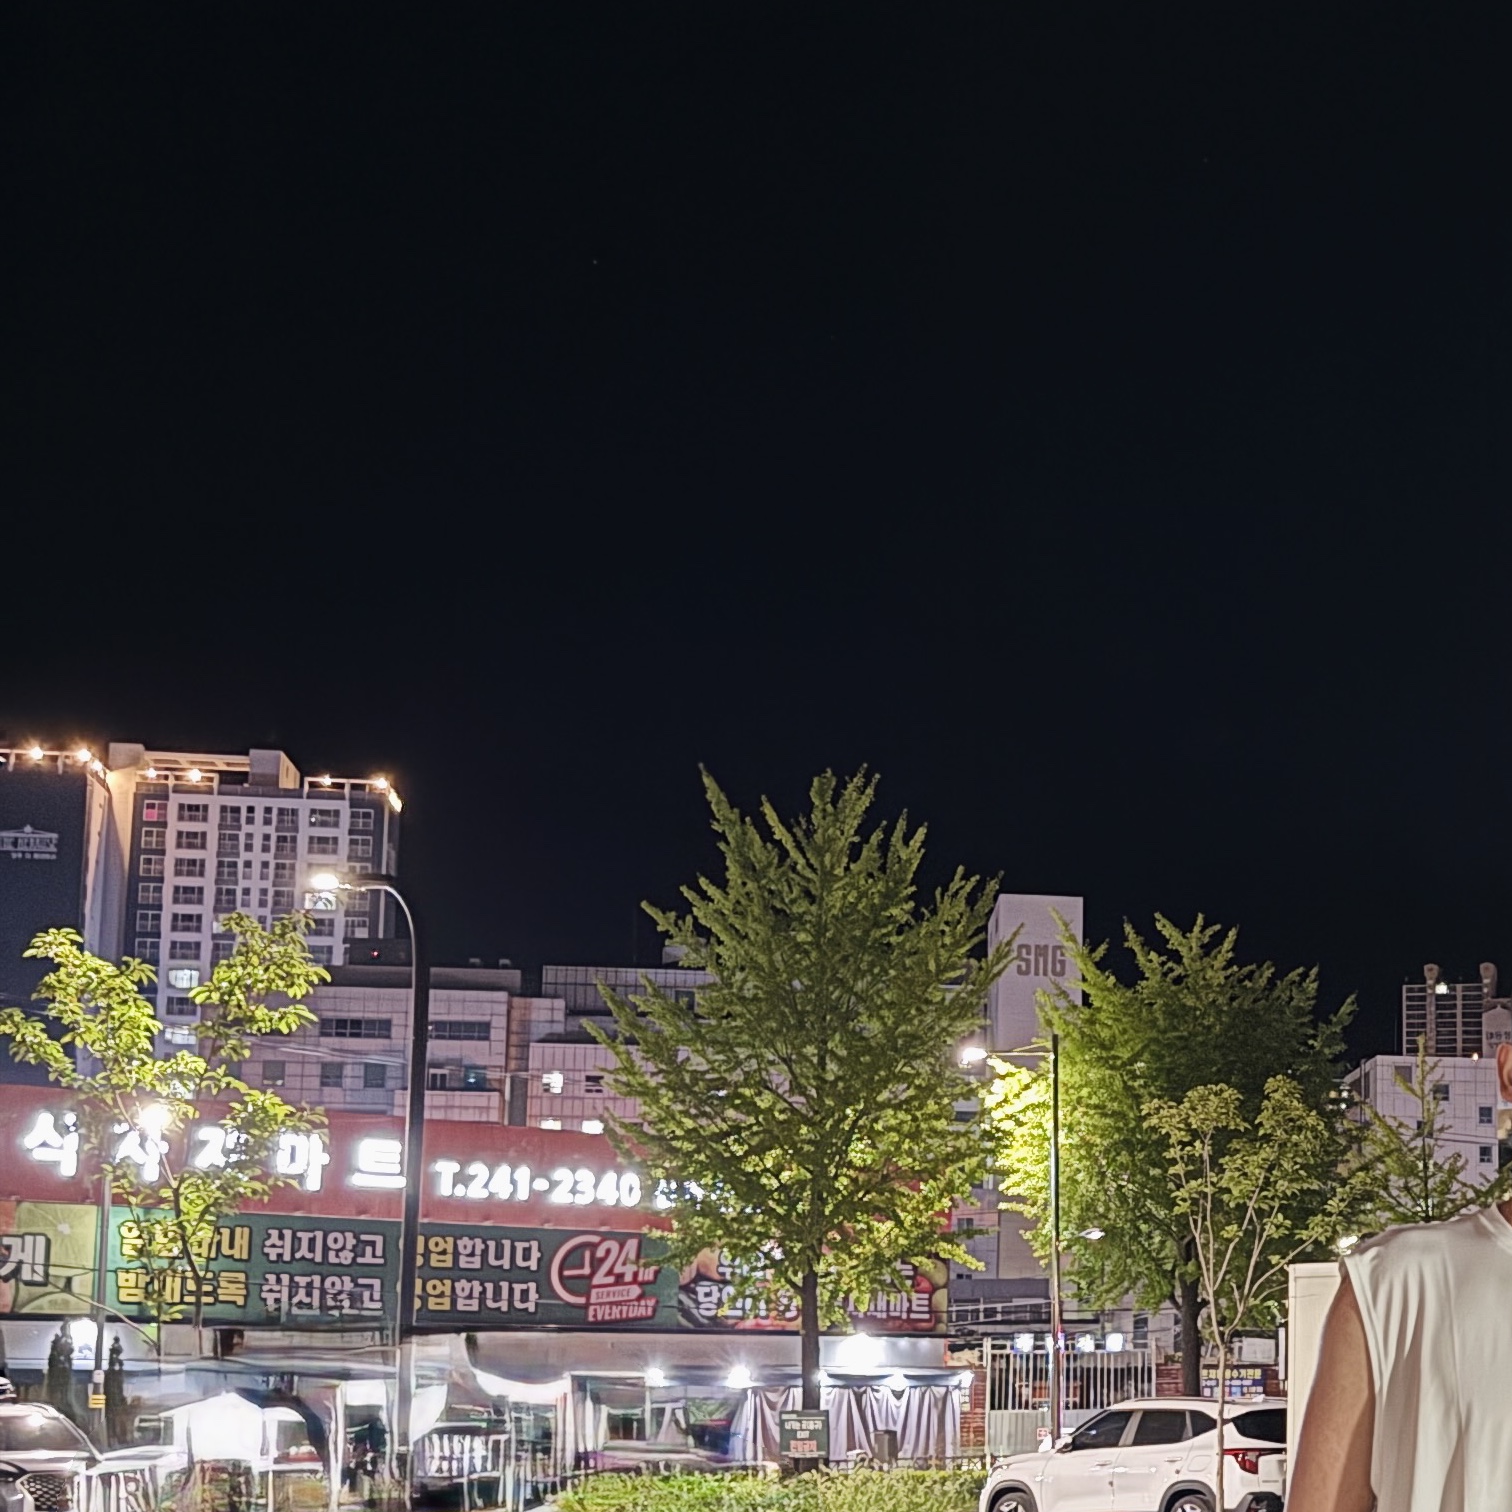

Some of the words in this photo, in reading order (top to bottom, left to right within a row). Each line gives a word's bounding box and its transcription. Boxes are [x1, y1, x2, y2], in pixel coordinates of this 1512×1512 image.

[1017, 943, 1067, 977] SMG
[434, 1160, 641, 1207] T.241-2340
[263, 1229, 385, 1264] 쉬지않고
[261, 1273, 384, 1316] 쉬지않고
[588, 1299, 657, 1322] EVERYDAY
[595, 1287, 632, 1300] SERVICE
